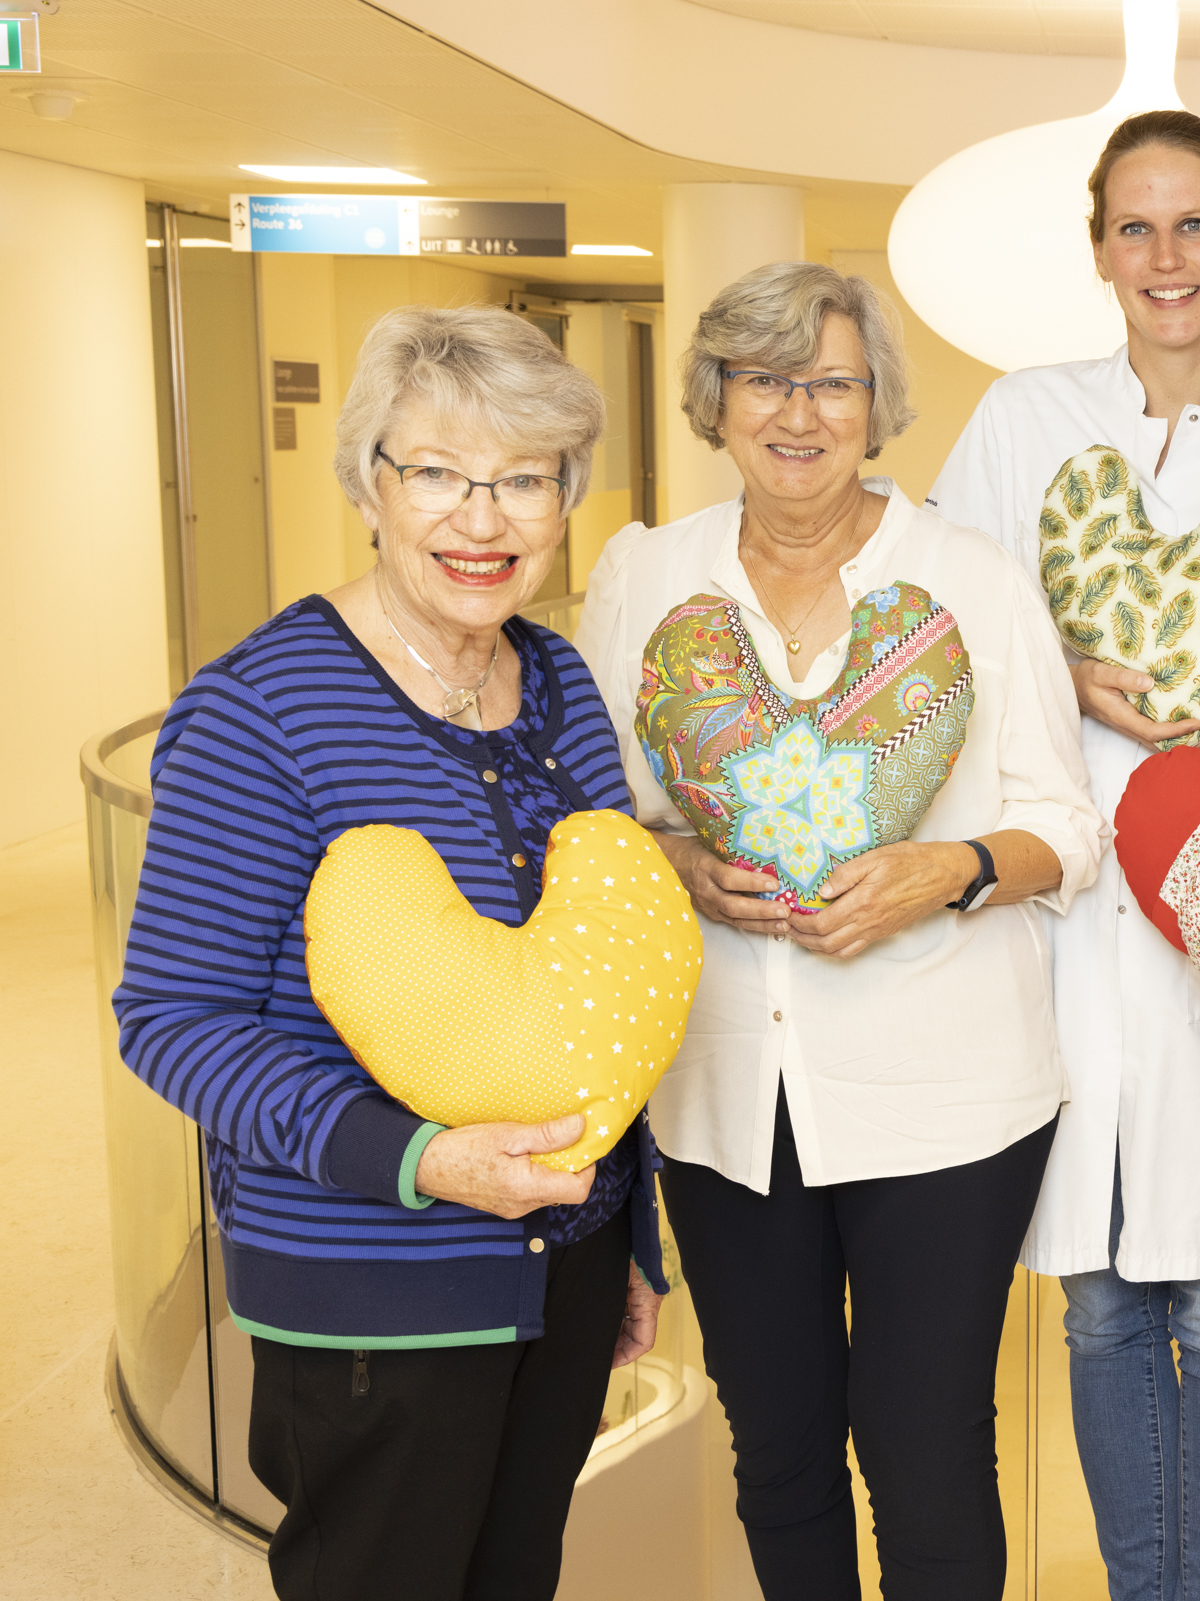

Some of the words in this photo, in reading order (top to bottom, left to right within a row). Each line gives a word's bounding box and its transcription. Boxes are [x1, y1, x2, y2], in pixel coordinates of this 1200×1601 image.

[420, 204, 460, 219] Lounge
[252, 218, 284, 230] Route
[288, 218, 303, 230] 36
[421, 240, 442, 252] UIT
